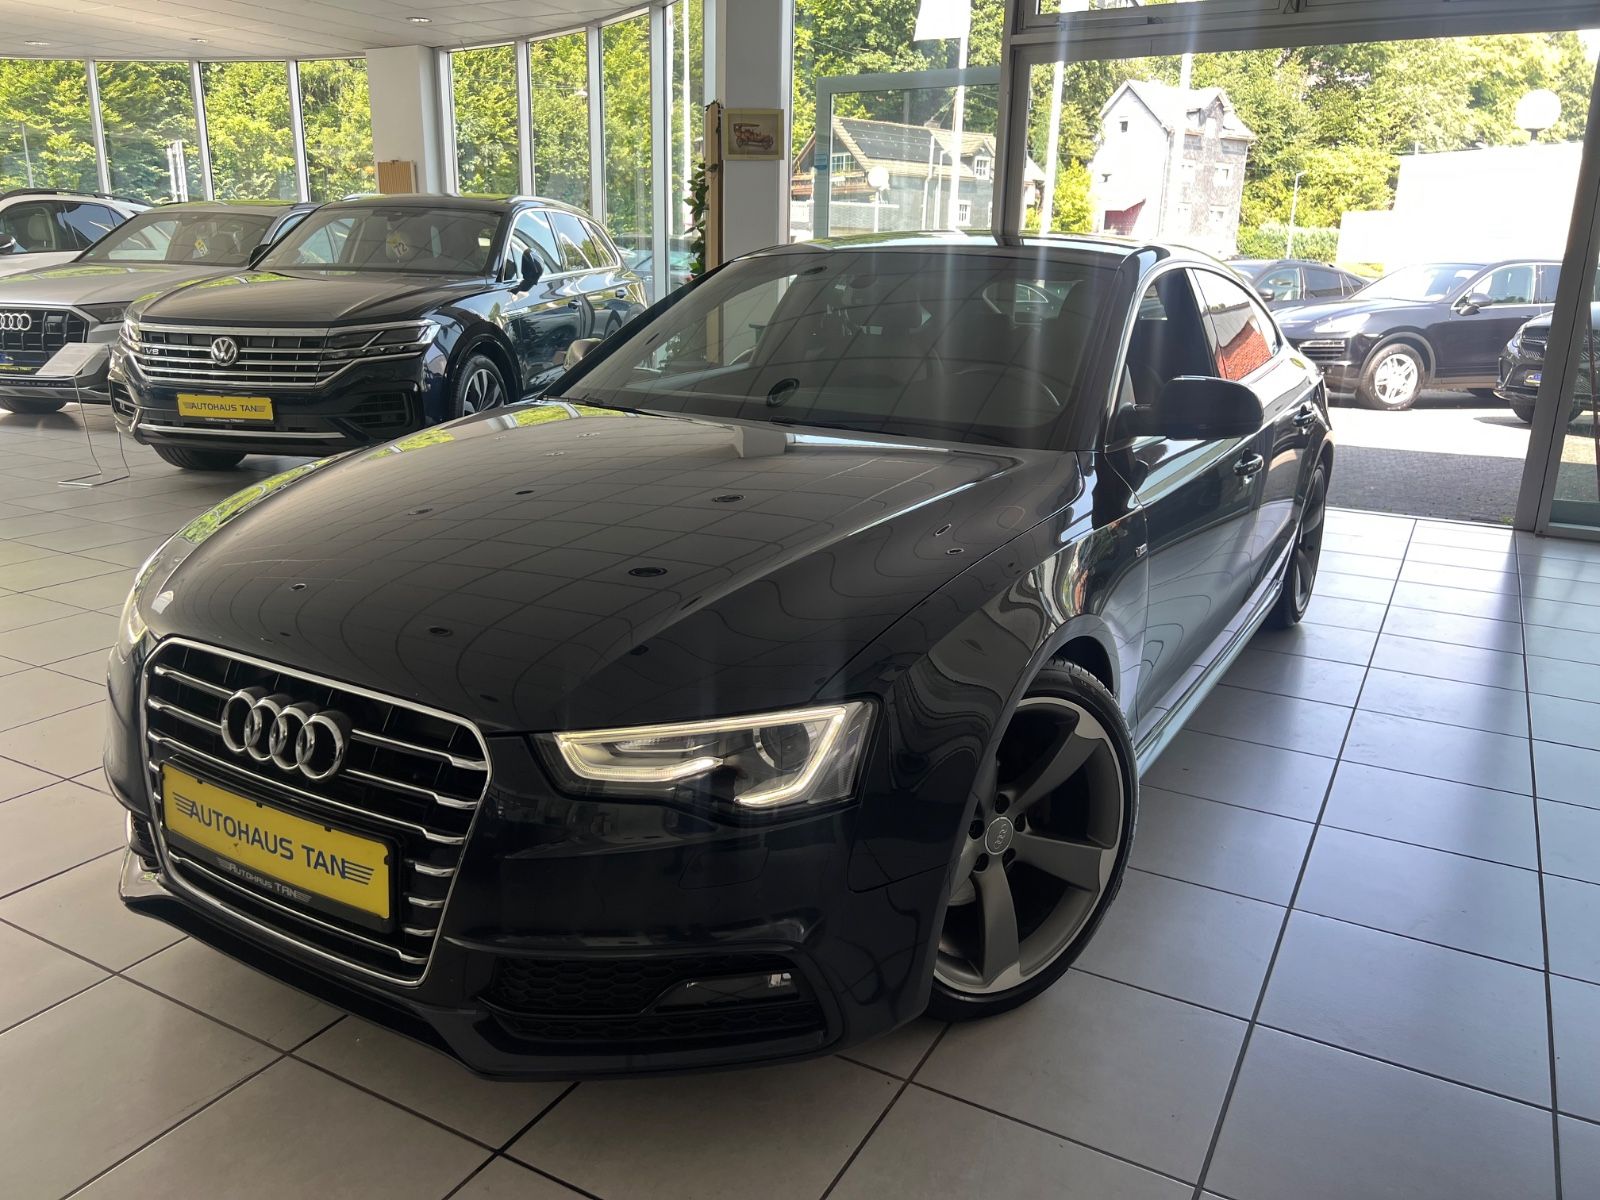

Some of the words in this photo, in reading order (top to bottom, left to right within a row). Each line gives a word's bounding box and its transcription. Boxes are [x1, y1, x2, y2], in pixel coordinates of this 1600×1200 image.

[191, 402, 238, 412] AUTOHAUS
[240, 404, 257, 413] TAN
[190, 800, 294, 861] AUTOHAUS
[301, 844, 347, 880] TAN
[274, 882, 298, 899] TAN
